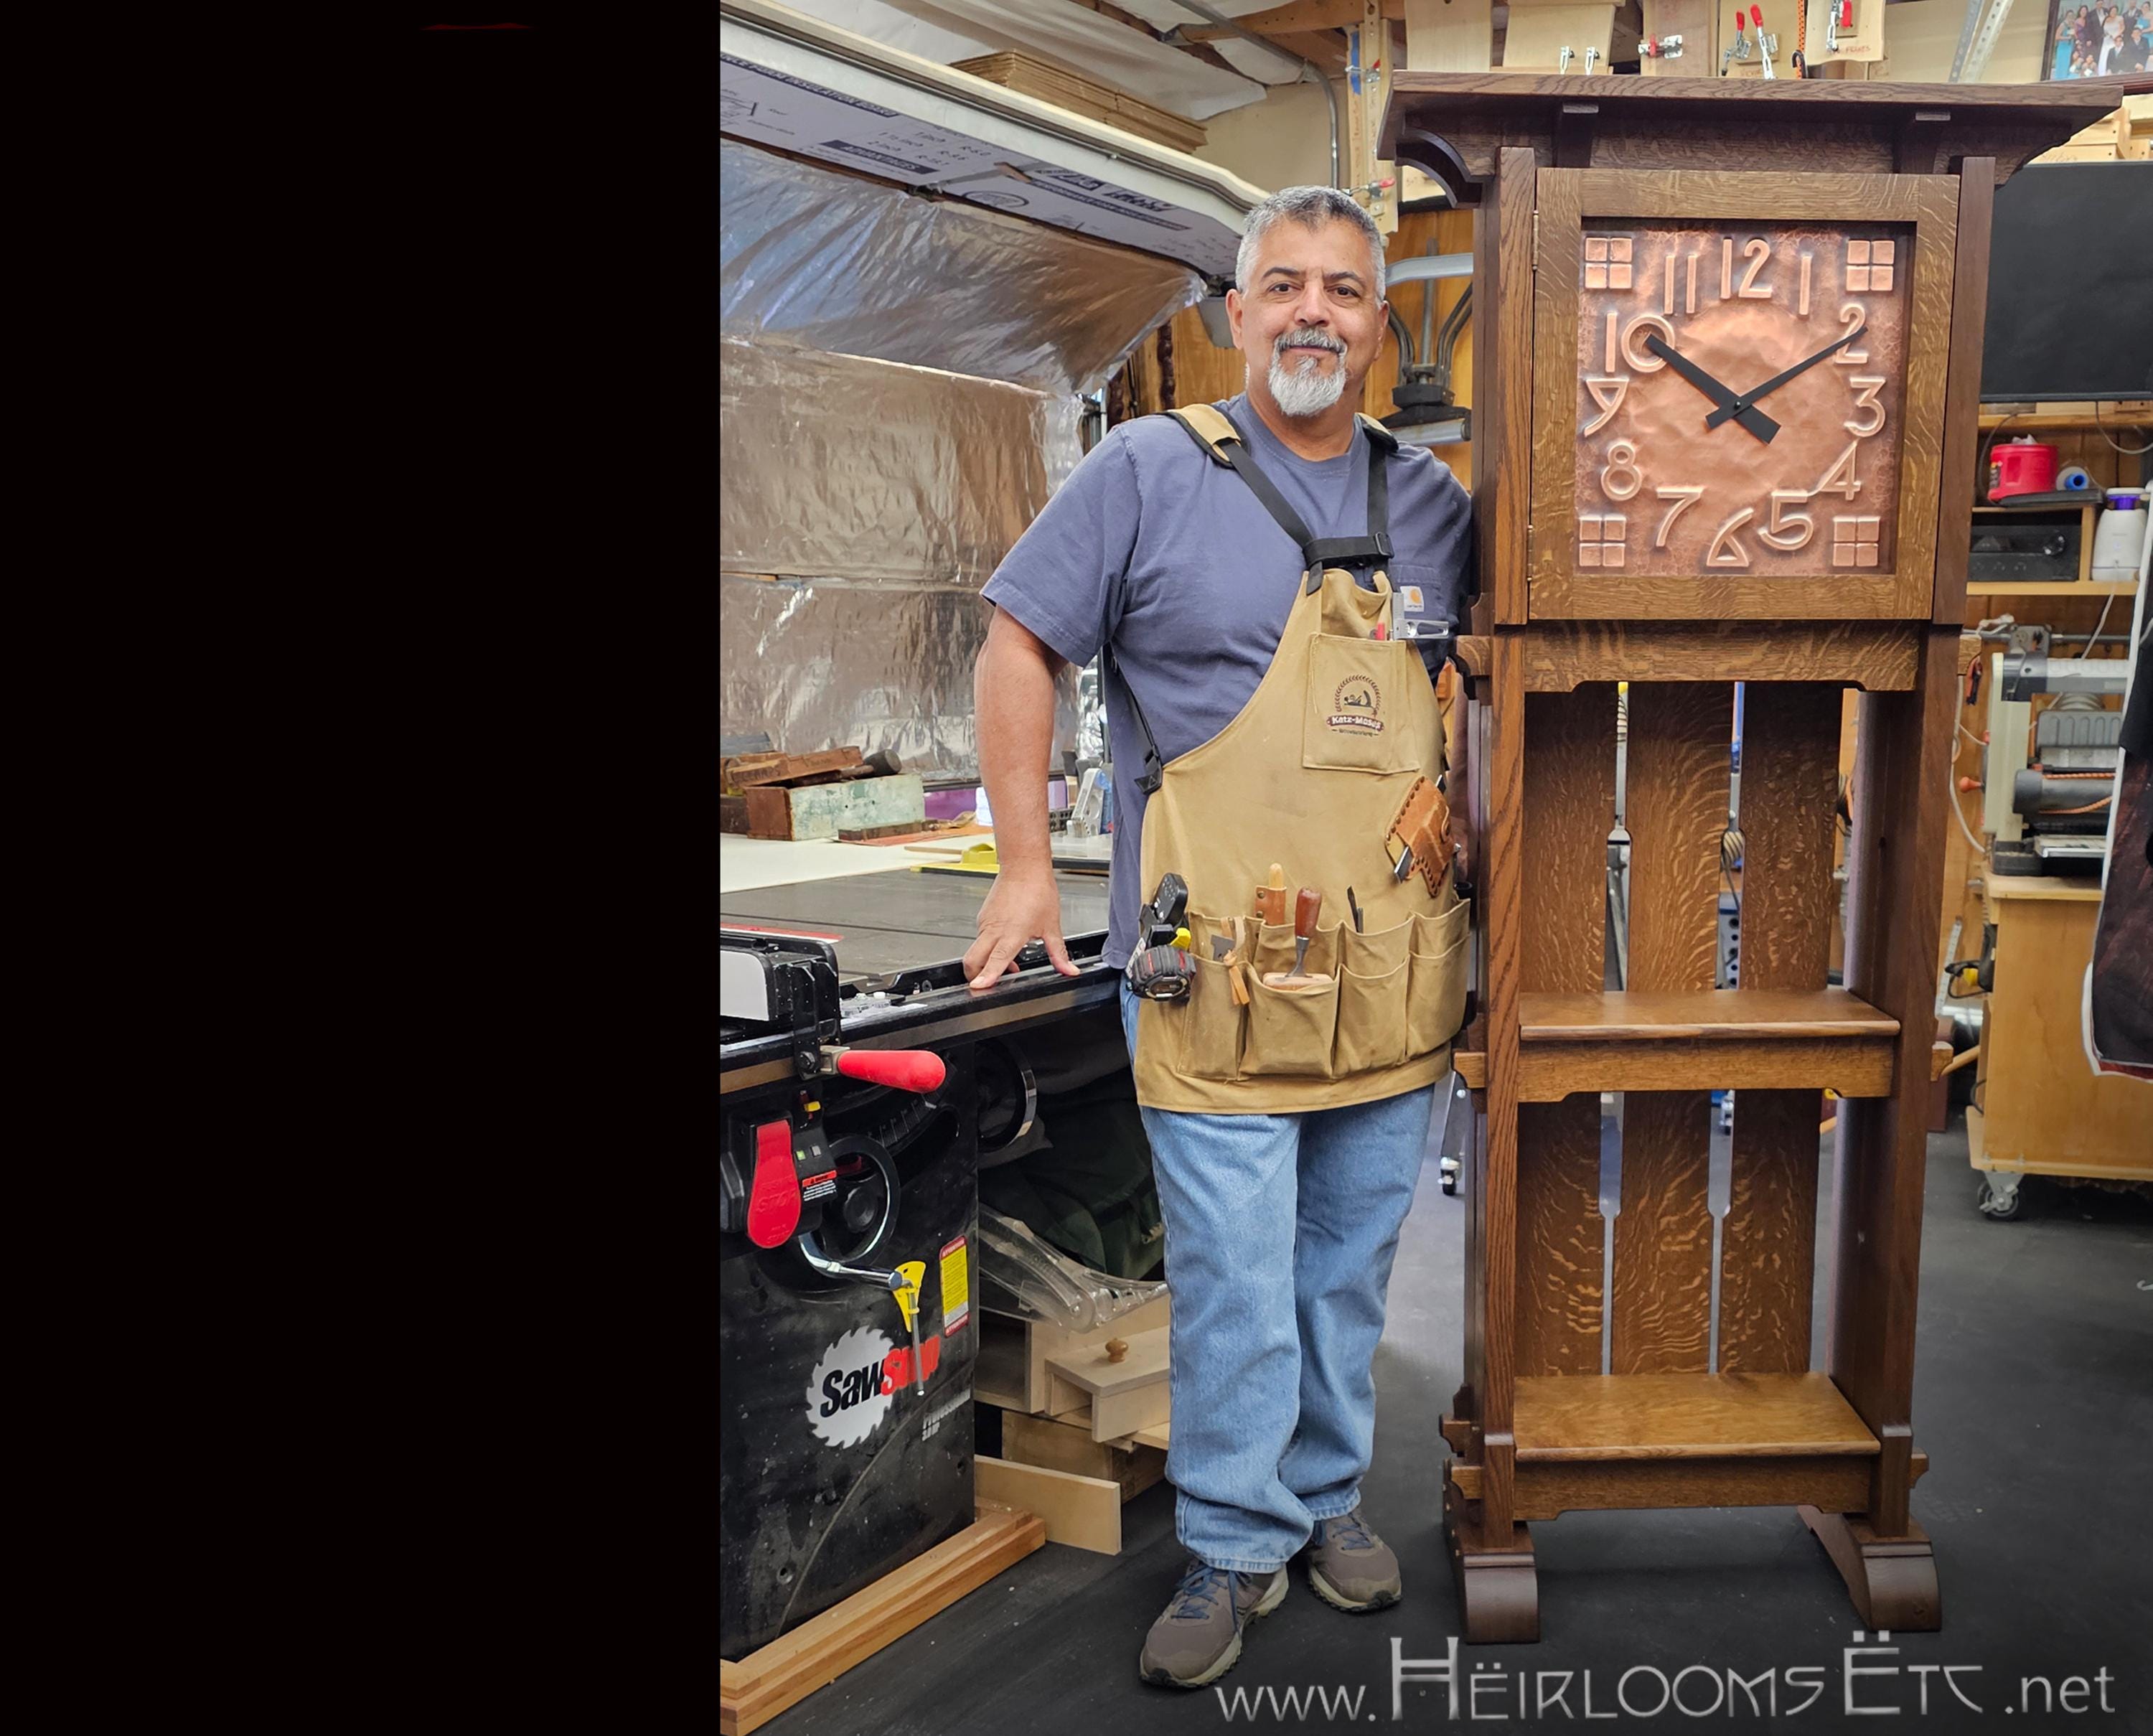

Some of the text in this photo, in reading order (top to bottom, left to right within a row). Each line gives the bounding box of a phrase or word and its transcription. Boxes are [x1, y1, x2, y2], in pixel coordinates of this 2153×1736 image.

[1664, 254, 1697, 315] 11
[1720, 238, 1773, 300] 12
[1798, 255, 1812, 316] 1
[1605, 312, 1676, 373] 10
[1834, 303, 1868, 365] 2
[1584, 377, 1630, 438] 9
[1843, 377, 1887, 438] 3
[1600, 440, 1643, 502] 8
[1816, 436, 1862, 502] 4
[1656, 485, 1707, 548] 7
[1706, 507, 1755, 568] 6
[1757, 488, 1815, 551] 5
[1331, 715, 1382, 730] Katz-Moses
